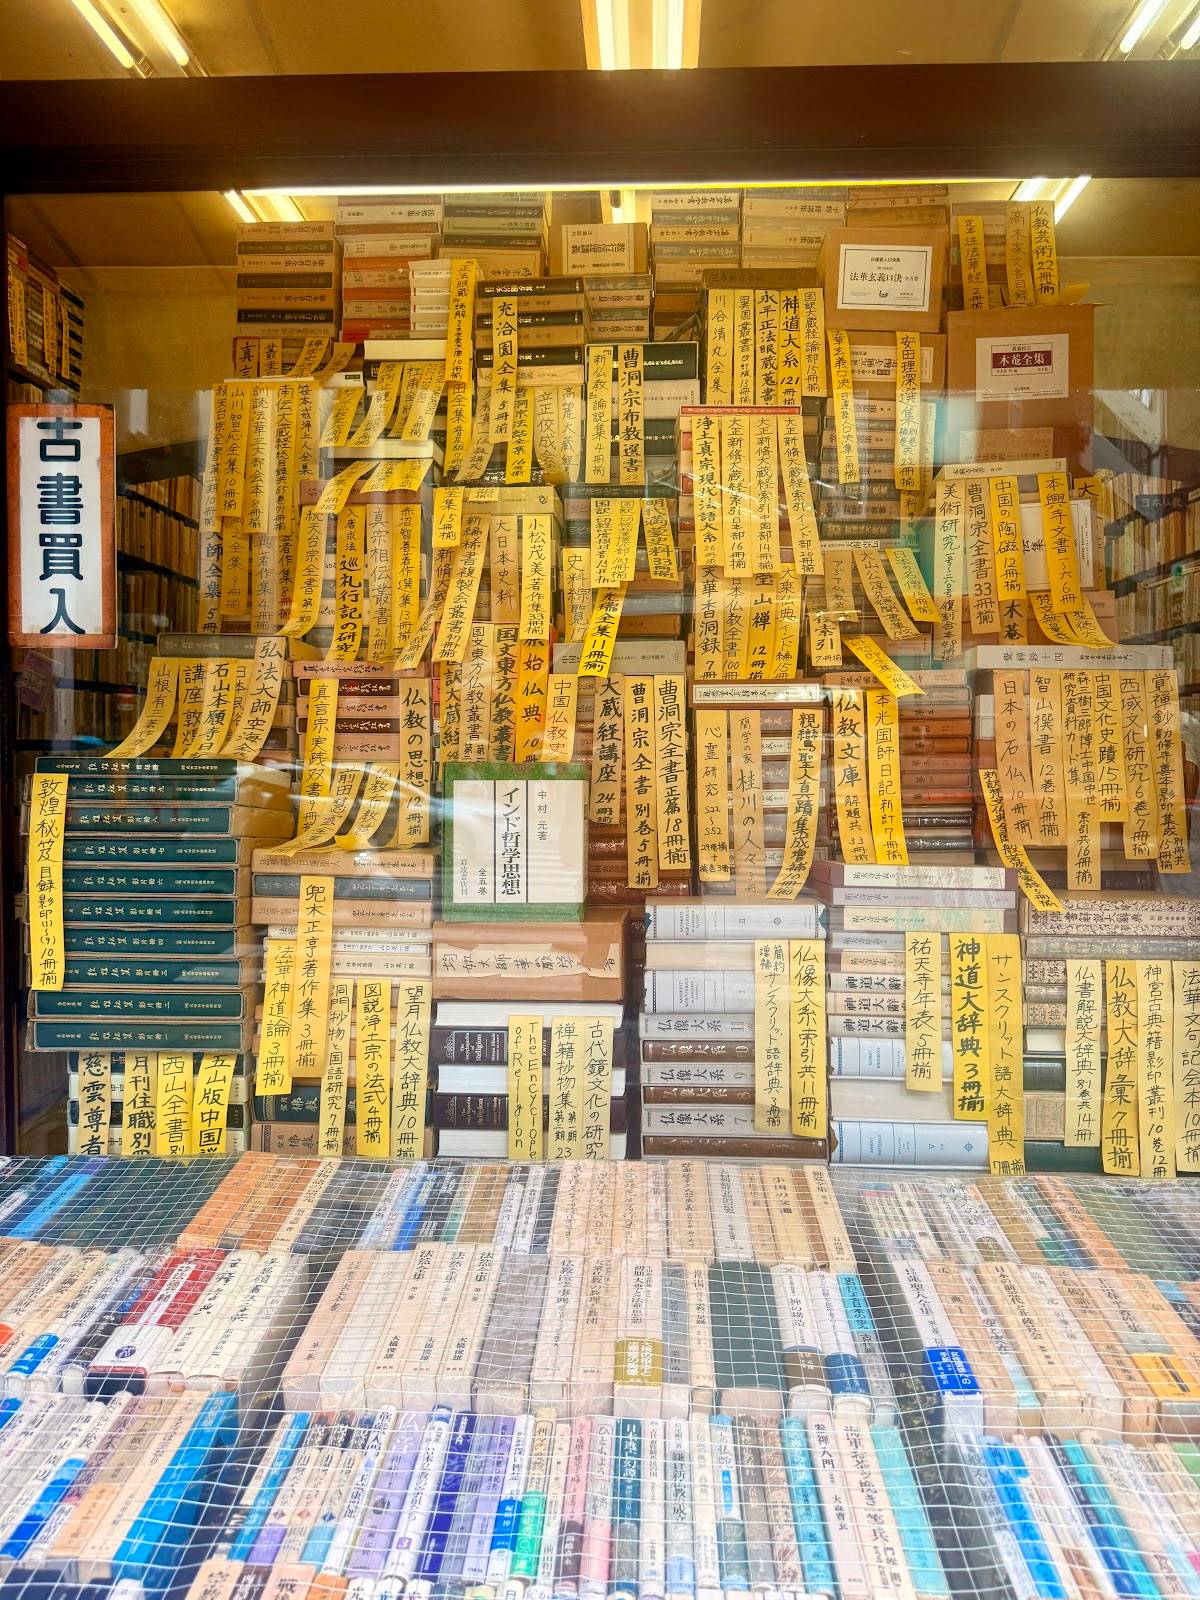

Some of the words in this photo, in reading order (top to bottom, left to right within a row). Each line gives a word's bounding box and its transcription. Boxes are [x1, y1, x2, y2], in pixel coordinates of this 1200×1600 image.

[849, 272, 903, 283] 法華玄義口決
[1032, 206, 1055, 296] 仏教芸術22冊揃
[491, 301, 517, 435] 充洽園全集5冊揃
[781, 295, 801, 405] 神道大系121冊揃
[999, 353, 1045, 367] 木菴全集
[224, 386, 245, 510] 山川智応全集10冊揃
[37, 416, 86, 635] 古書買入
[494, 519, 516, 610] 大日本史料
[524, 518, 547, 635] 小松茂美著作集33冊揃
[967, 482, 997, 626] 曹洞宗全書33冊揃
[994, 480, 1024, 593] 中国の陶磁12冊揃
[462, 626, 488, 742] 国文東方仏教叢書
[490, 626, 519, 761] 国文東方仏教叢書
[546, 679, 572, 756] 中国仏教史
[596, 677, 623, 824] 大蔵経講座24冊揃
[1094, 671, 1124, 813] 中国文化史蹟15冊揃
[402, 687, 430, 836] 仏教の思想12冊揃
[537, 789, 549, 841] 中村元著
[631, 683, 655, 887] 曹洞宗全書別巻5冊揃
[658, 680, 690, 865] 曹洞宗全書正篇18冊揃
[834, 694, 869, 861] 仏教文庫解題共33冊揃
[875, 693, 904, 861] 本光国師日記新訂7冊揃
[998, 679, 1034, 840] 日本の石仏10冊揃
[1032, 674, 1060, 838] 智山撰書12巻13冊揃
[1120, 677, 1151, 857] 西域文化研究6巻7冊揃
[477, 867, 488, 895] 全五巻
[501, 786, 521, 896] インド哲学思想
[322, 984, 349, 1153] 洞門抄物と国語研究7冊揃
[361, 983, 388, 1144] 図説浄土宗の法式4冊揃
[394, 985, 425, 1157] 望月仏教大辞典10冊揃
[555, 1023, 578, 1110] 禅籍抄物集
[656, 1018, 723, 1033] 仏像大系
[659, 1068, 725, 1083] 仏像大系
[662, 1043, 727, 1056] 仏像大系
[792, 943, 821, 1131] 仏像大系索引共11冊揃
[907, 937, 939, 1080] 祐天寺年表5冊揃
[954, 938, 987, 1113] 神道大辞典3冊揃
[991, 953, 1019, 1150] サンスクリット語大辞典
[81, 1053, 109, 1155] 慈雲尊者
[512, 1052, 523, 1149] Religion
[582, 1020, 610, 1160] 古代鏡文化の研究
[659, 1111, 726, 1127] 仏像大系
[662, 1086, 728, 1099] 仏像大系
